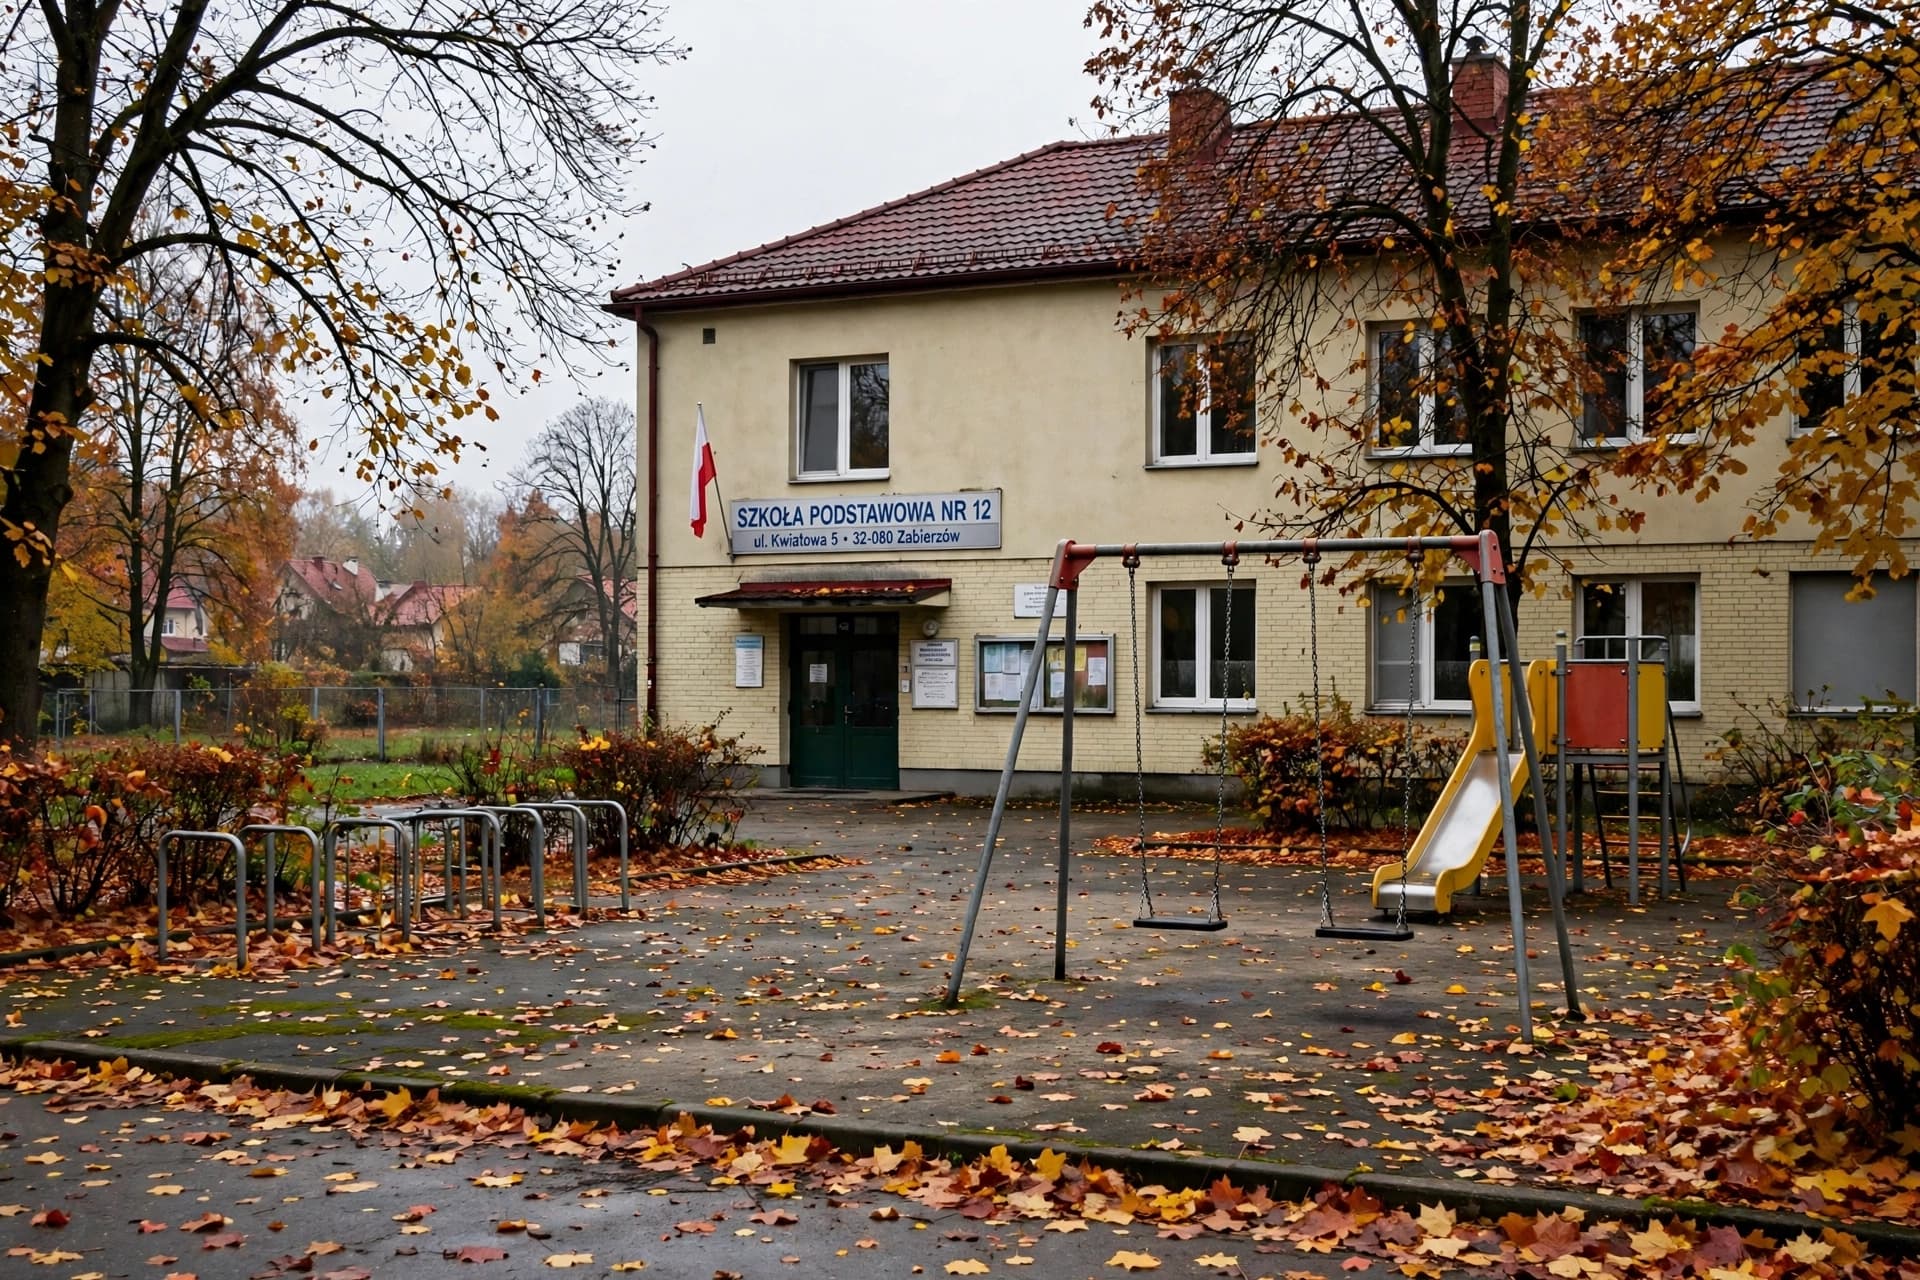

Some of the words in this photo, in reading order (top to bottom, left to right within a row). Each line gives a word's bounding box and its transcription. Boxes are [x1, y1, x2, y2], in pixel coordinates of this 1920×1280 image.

[737, 506, 804, 528] SZKOŁA
[810, 501, 935, 525] PODSTAWOWA
[941, 500, 966, 521] NR
[972, 499, 991, 520] 12
[754, 534, 767, 548] ul.
[771, 533, 827, 548] Kwiatowa
[831, 532, 838, 545] 5
[852, 530, 893, 545] 32-080
[897, 528, 960, 544] Zabierzów
